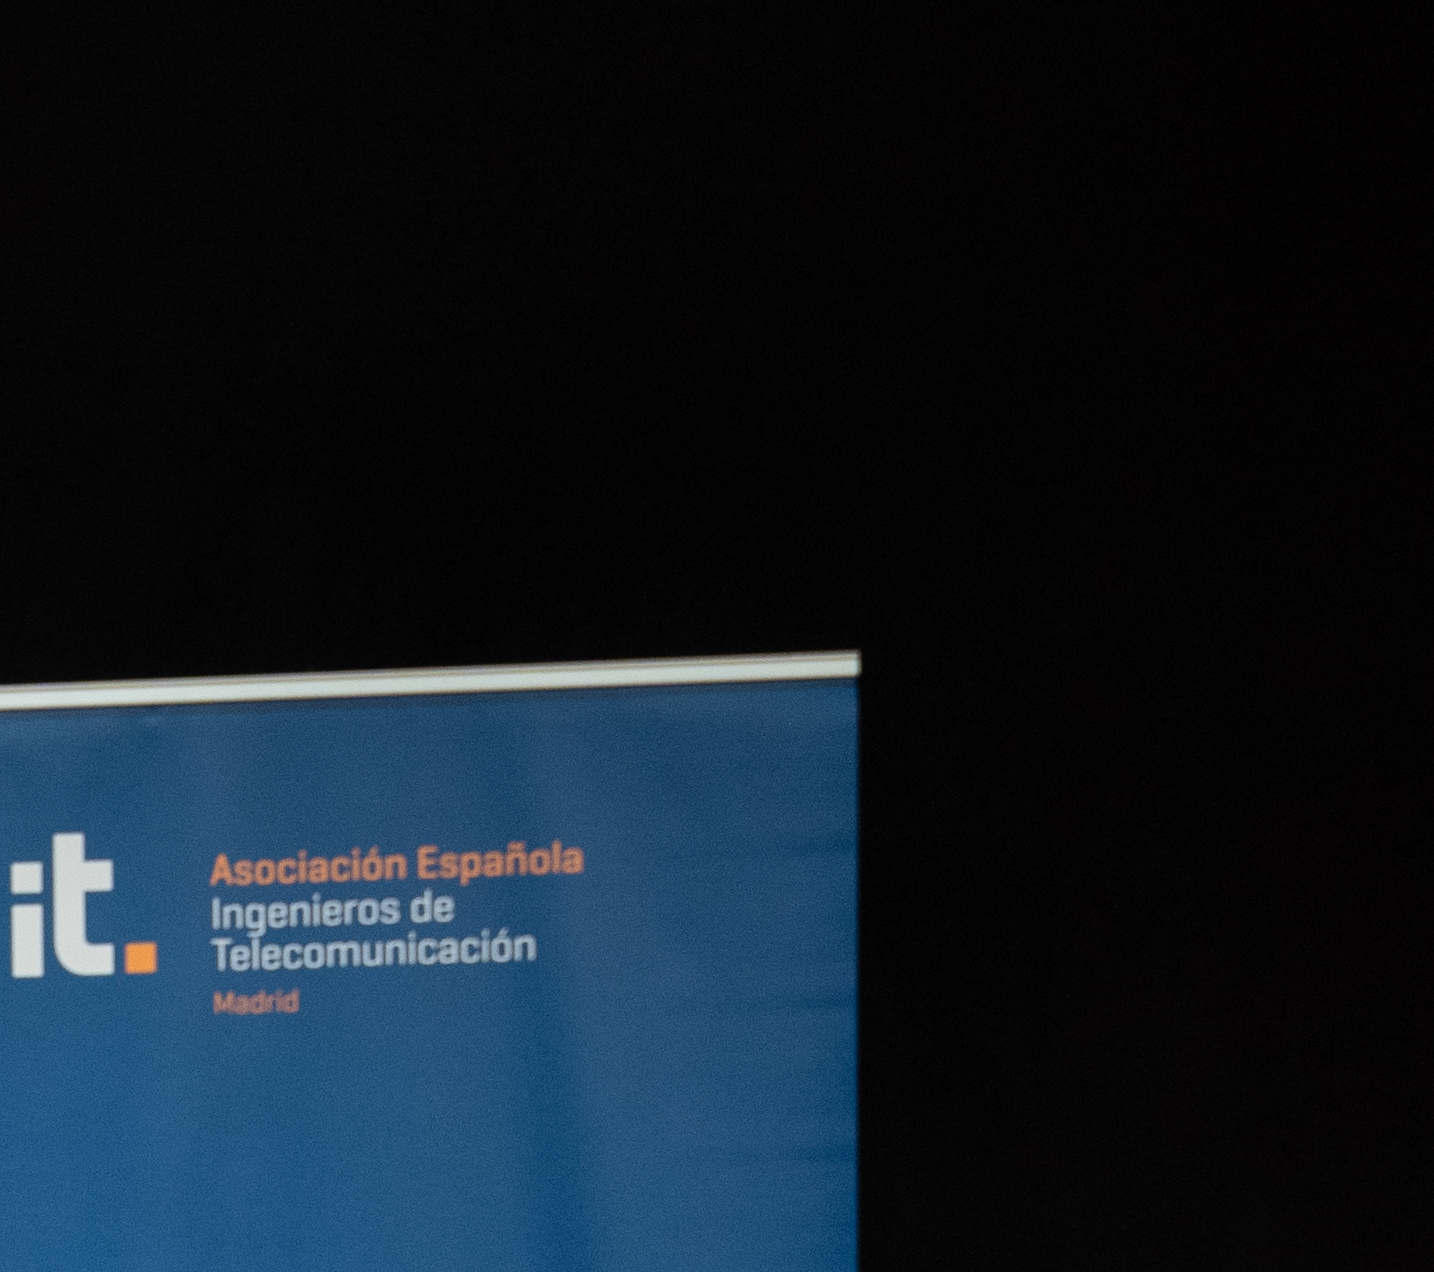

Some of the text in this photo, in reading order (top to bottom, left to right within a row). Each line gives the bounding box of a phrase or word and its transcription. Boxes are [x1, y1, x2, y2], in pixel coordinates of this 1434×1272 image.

[209, 840, 585, 886] Asociación Española
[210, 889, 454, 938] Ingenieros de
[209, 928, 537, 972] Telecomunicación
[213, 988, 300, 1015] Madrid
